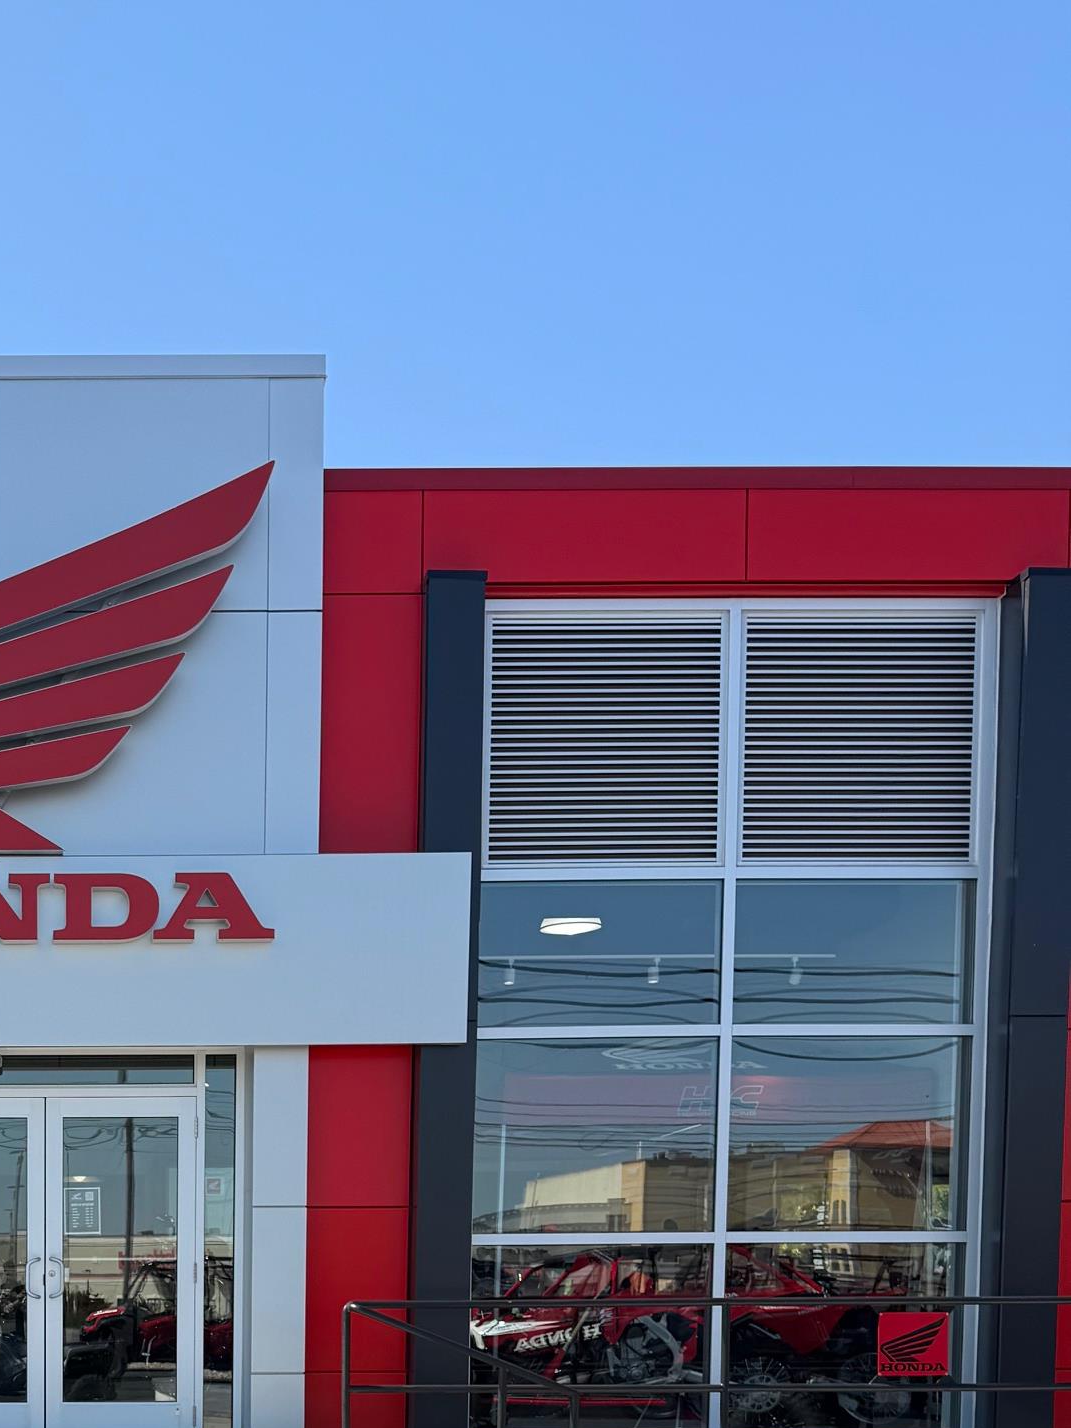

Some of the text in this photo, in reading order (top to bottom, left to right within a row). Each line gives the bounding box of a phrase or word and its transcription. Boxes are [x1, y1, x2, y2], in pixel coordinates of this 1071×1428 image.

[615, 1060, 768, 1071] HONA
[677, 1085, 764, 1112] HC
[880, 1362, 946, 1372] HONDA
